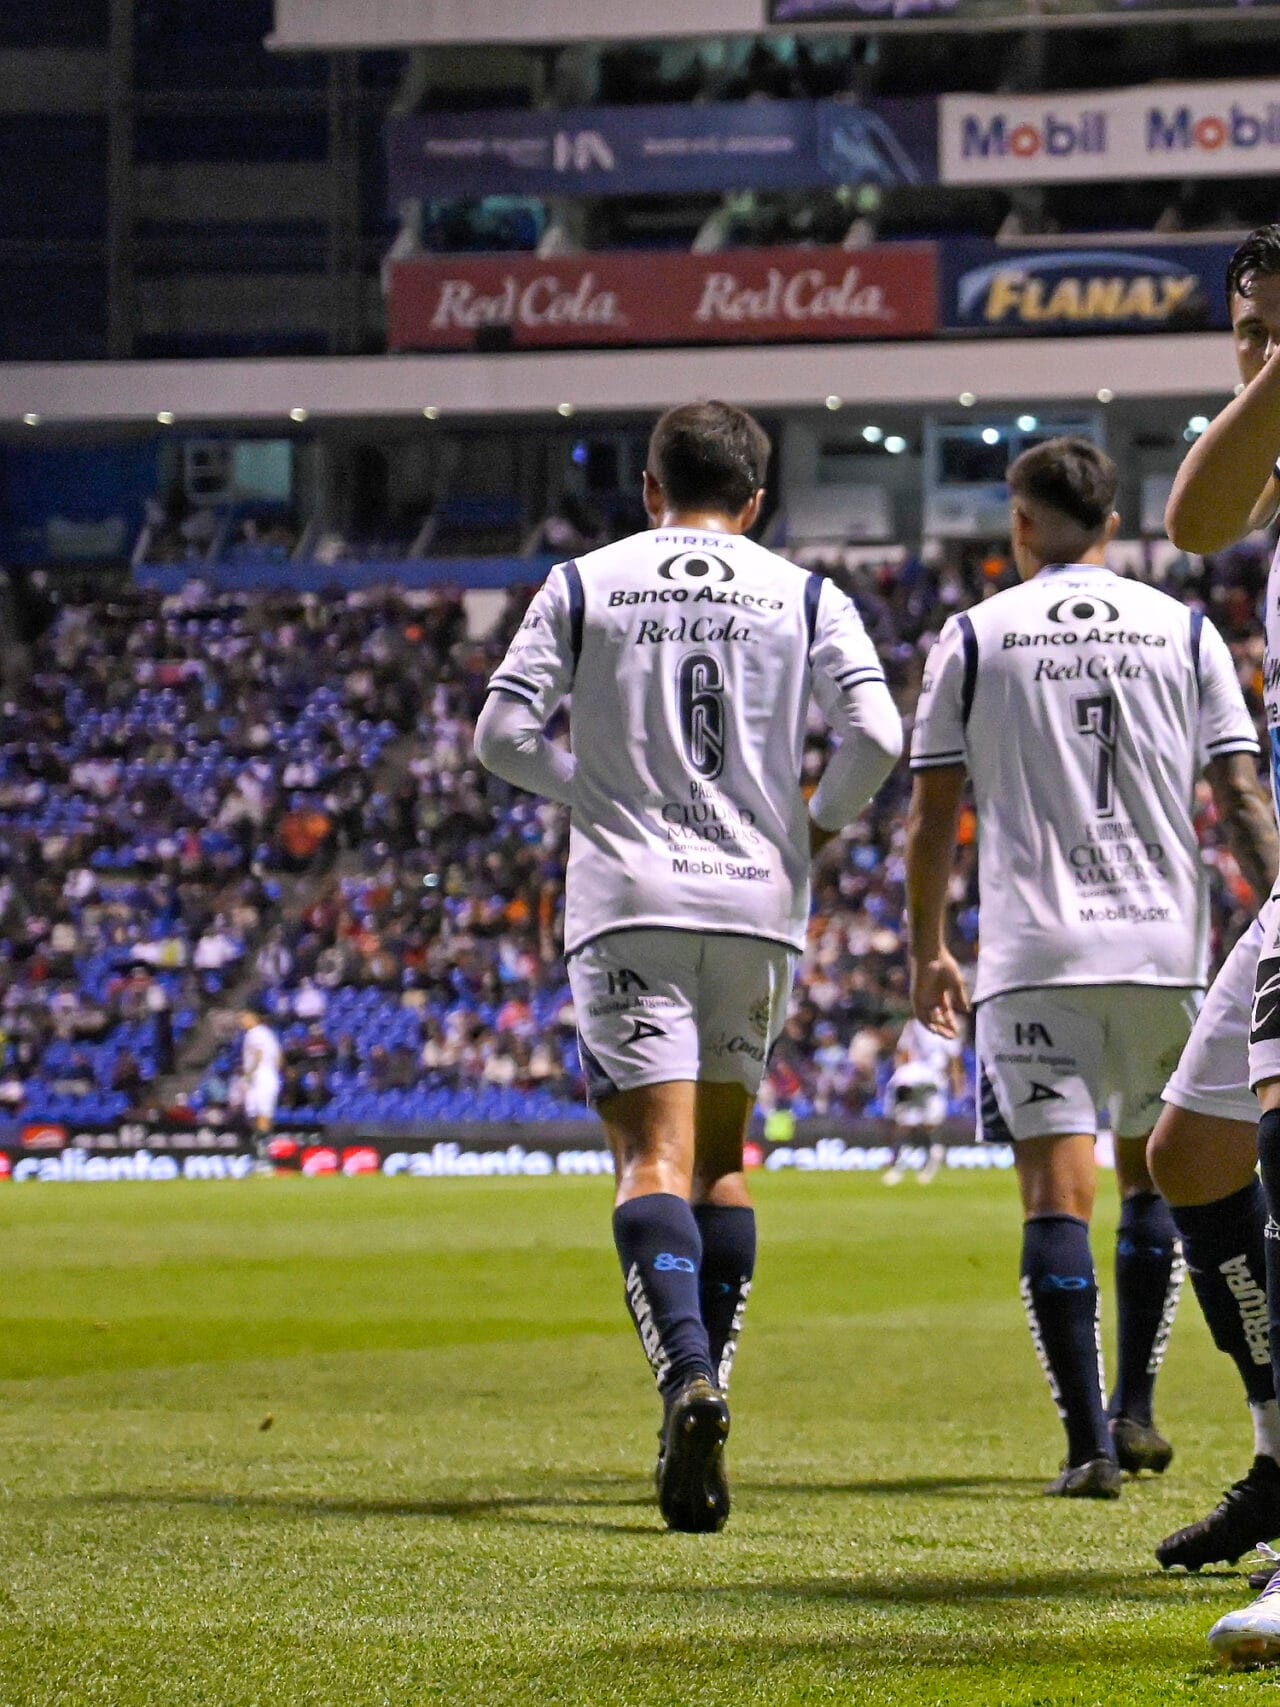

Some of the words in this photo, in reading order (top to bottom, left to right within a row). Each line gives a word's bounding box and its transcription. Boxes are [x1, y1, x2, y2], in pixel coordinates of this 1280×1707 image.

[960, 111, 1107, 160] Mobil
[985, 273, 1197, 322] FLANAX
[607, 587, 688, 608] Banco
[692, 585, 784, 611] Azteca
[1002, 630, 1077, 651] Banco
[1083, 627, 1167, 648] Azteca
[676, 650, 724, 782] 6
[1070, 691, 1118, 819] 7
[661, 802, 756, 826] CIUDD
[672, 858, 723, 876] Mobil
[725, 862, 771, 879] Super
